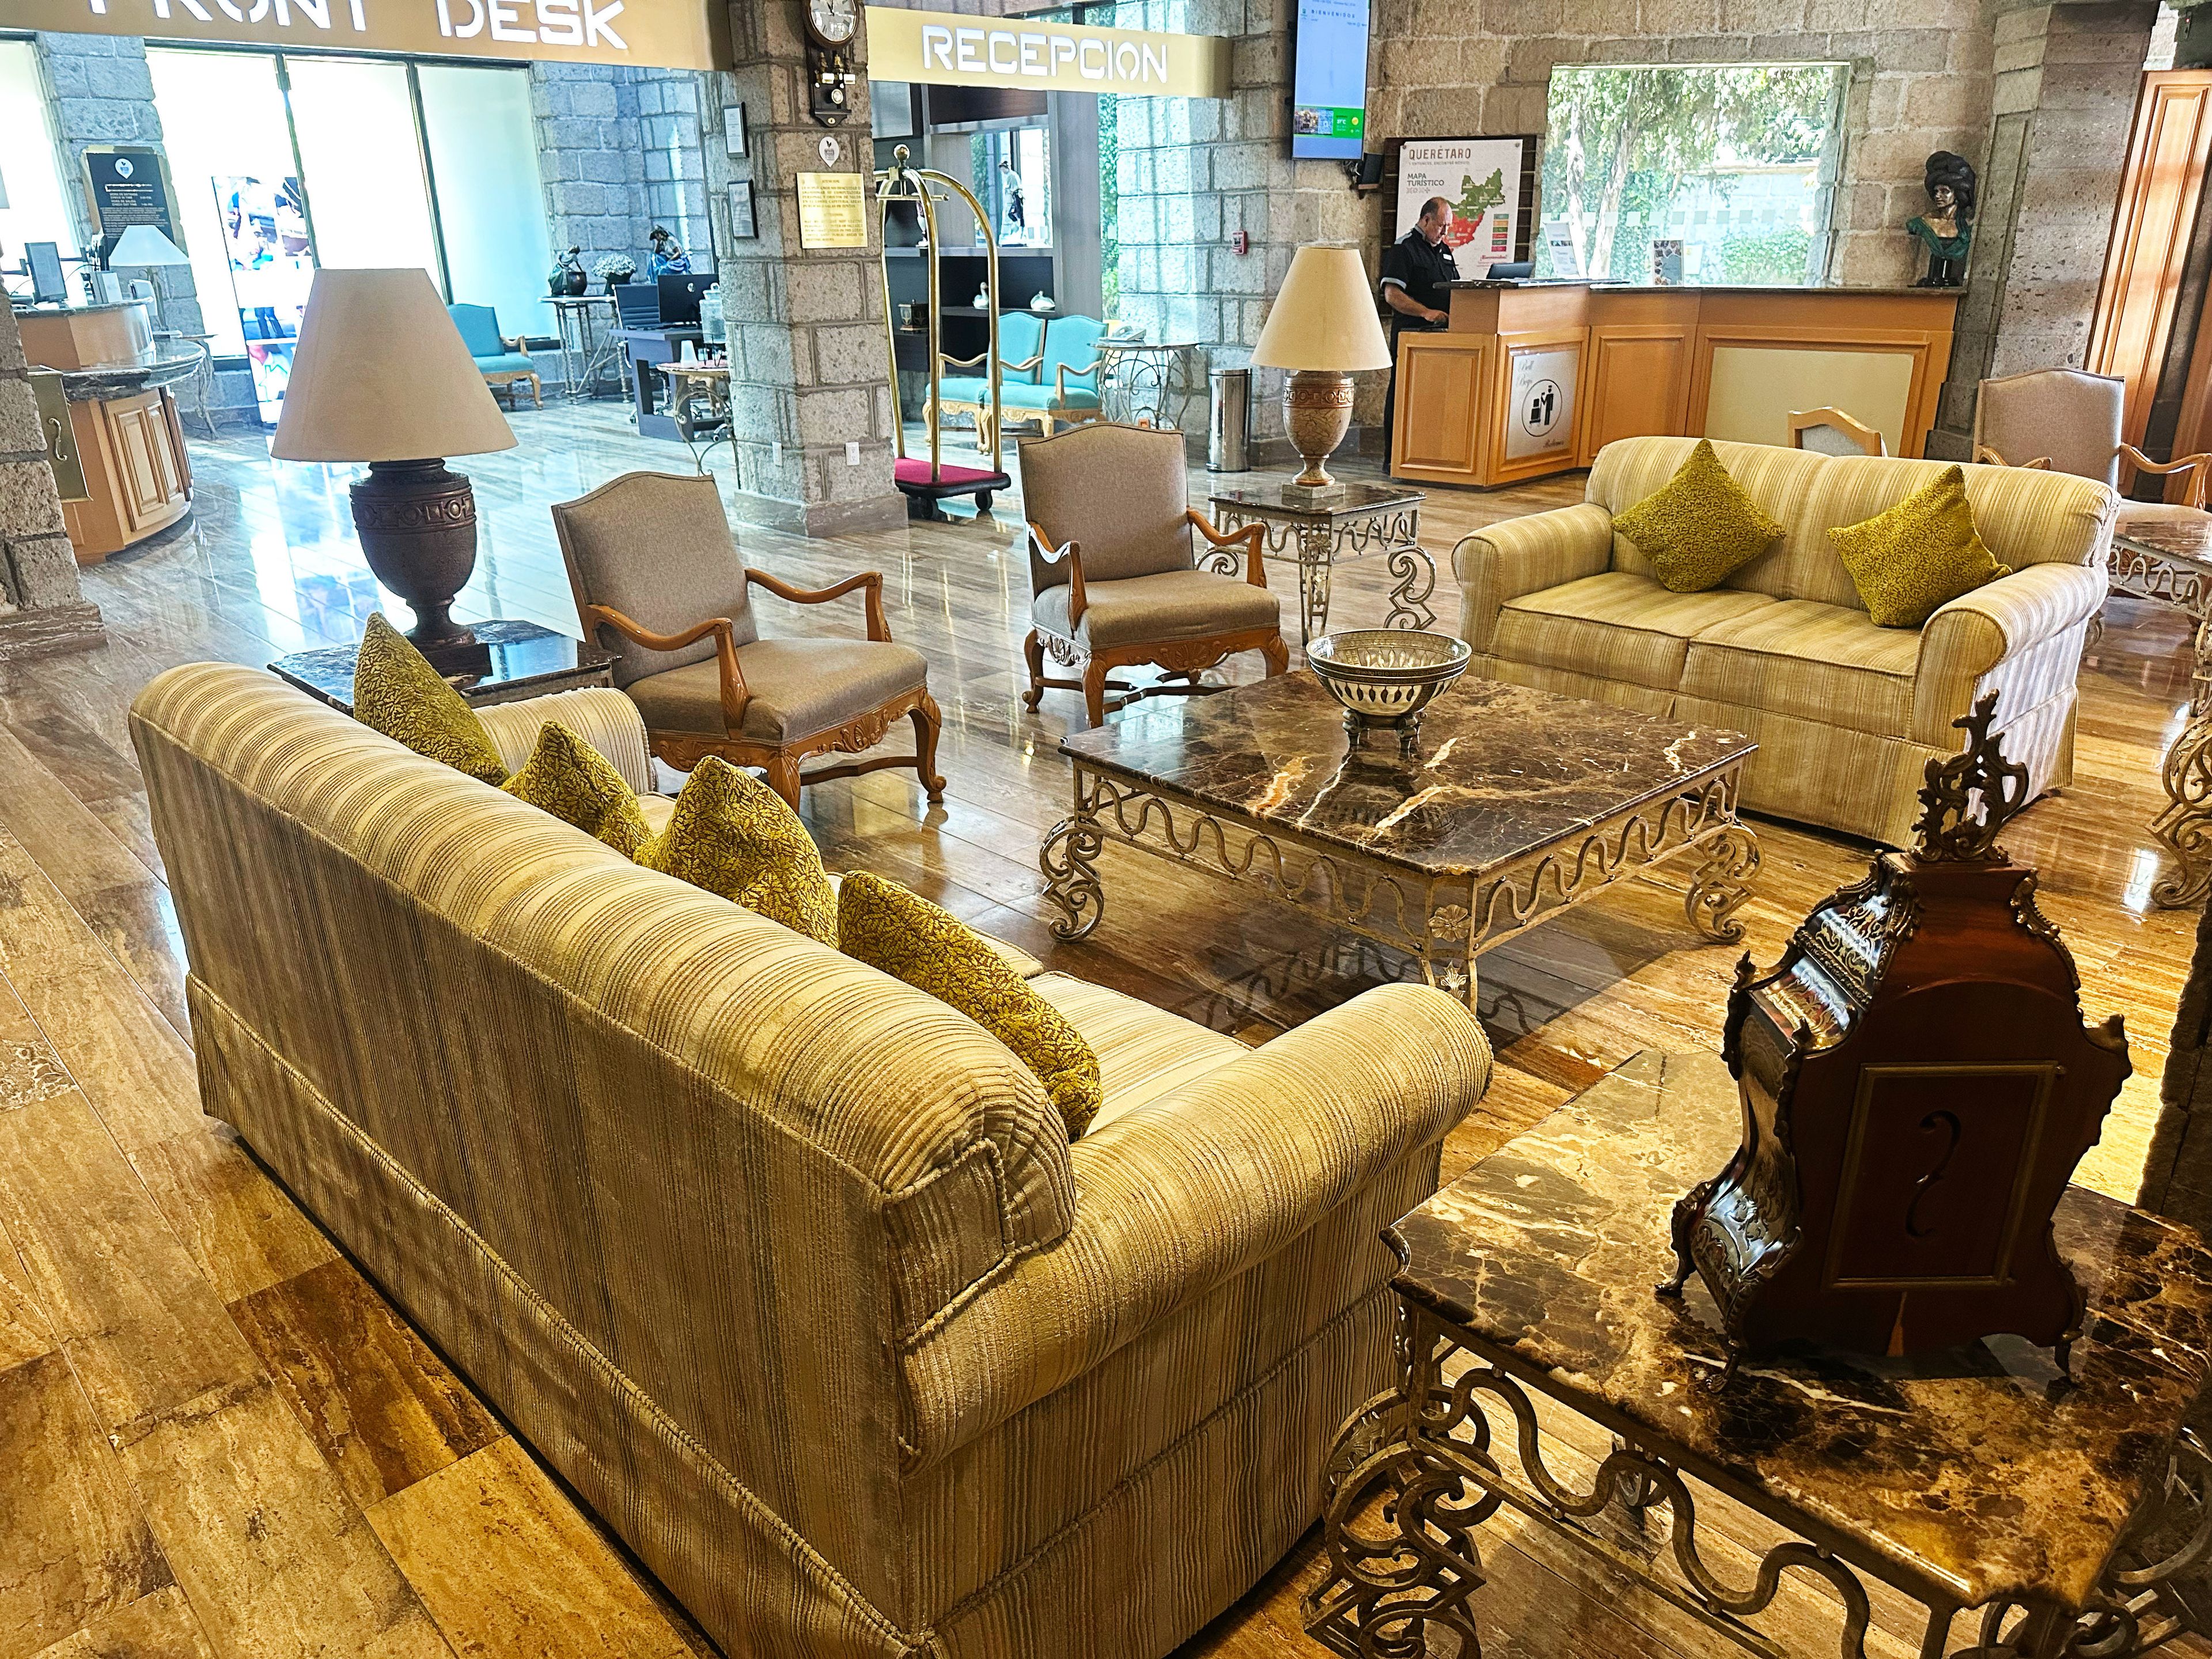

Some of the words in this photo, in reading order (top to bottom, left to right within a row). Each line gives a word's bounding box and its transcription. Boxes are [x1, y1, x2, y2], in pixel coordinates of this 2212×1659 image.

[435, 0, 628, 50] DESK
[922, 25, 1168, 84] RECEPCION
[1409, 145, 1471, 160] QUERÉTARO
